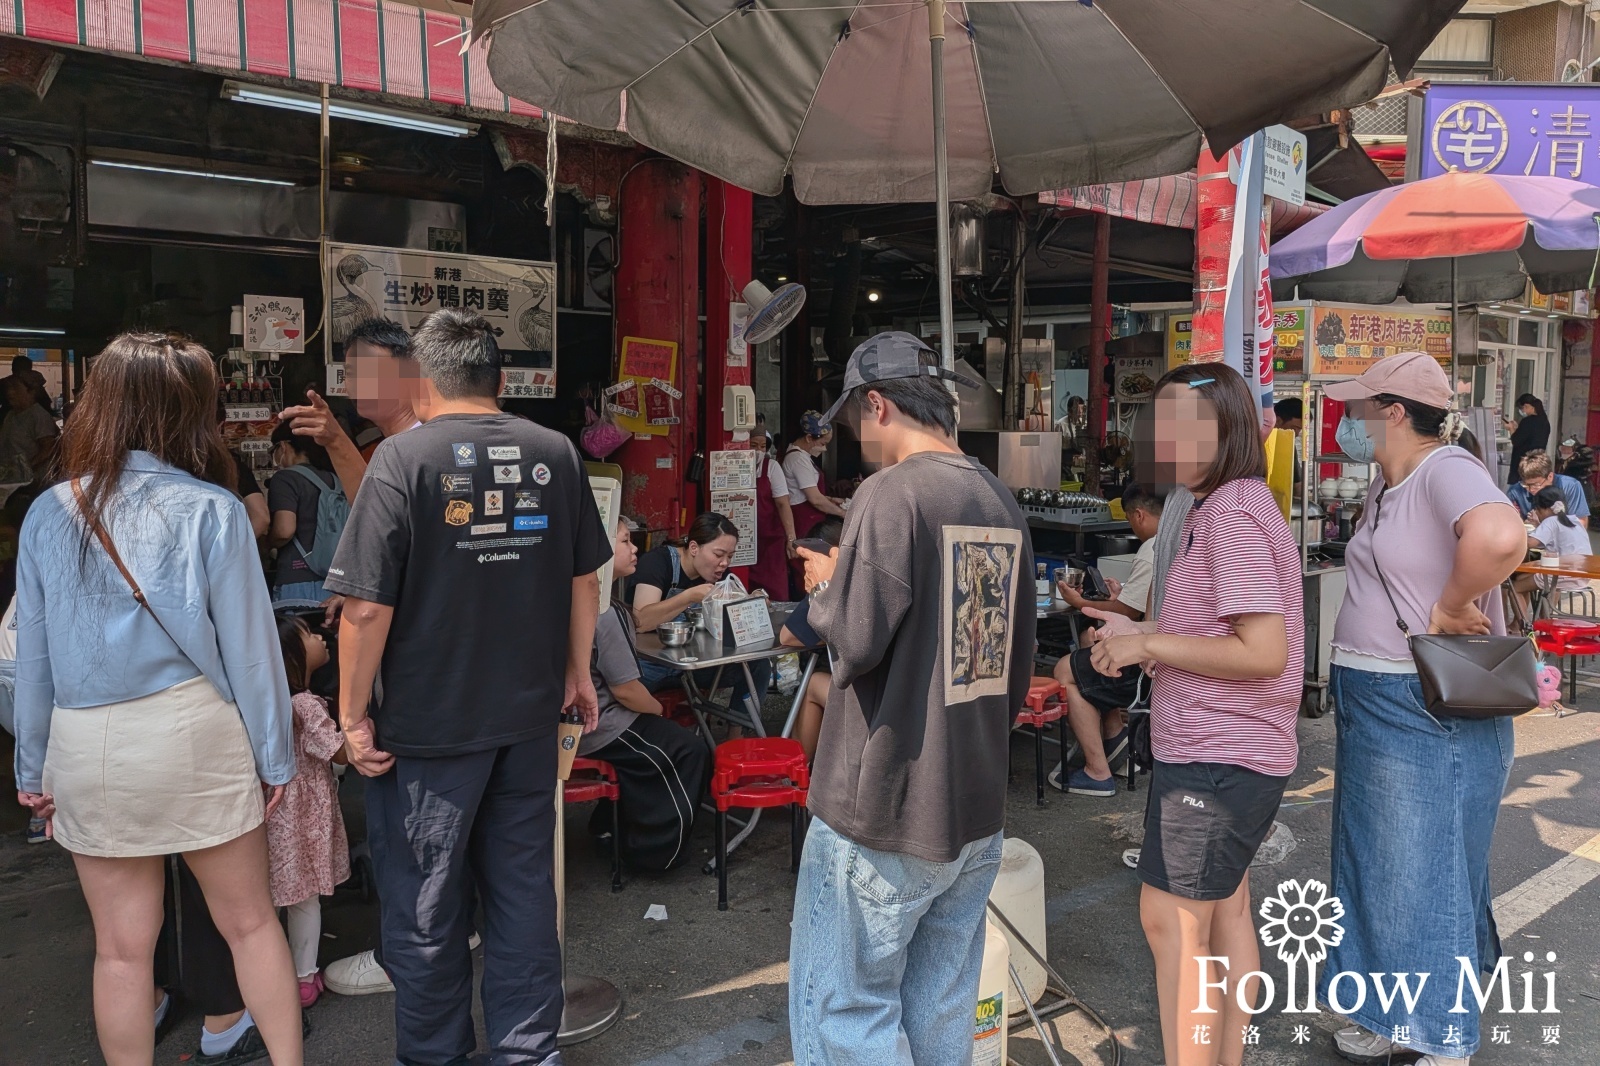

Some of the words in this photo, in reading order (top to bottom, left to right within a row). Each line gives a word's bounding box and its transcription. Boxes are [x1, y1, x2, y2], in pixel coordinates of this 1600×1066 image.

[1264, 136, 1291, 157] 散避難設施
[1523, 104, 1592, 178] 清
[434, 267, 462, 282] 新港
[384, 281, 509, 313] 生炒鴨肉羹
[1350, 313, 1426, 345] 新港肉粽秀
[1278, 334, 1297, 346] 30
[503, 385, 554, 397] 全家免運中
[255, 410, 270, 418] $50
[484, 552, 520, 562] Columbia
[1182, 795, 1205, 809] FILA
